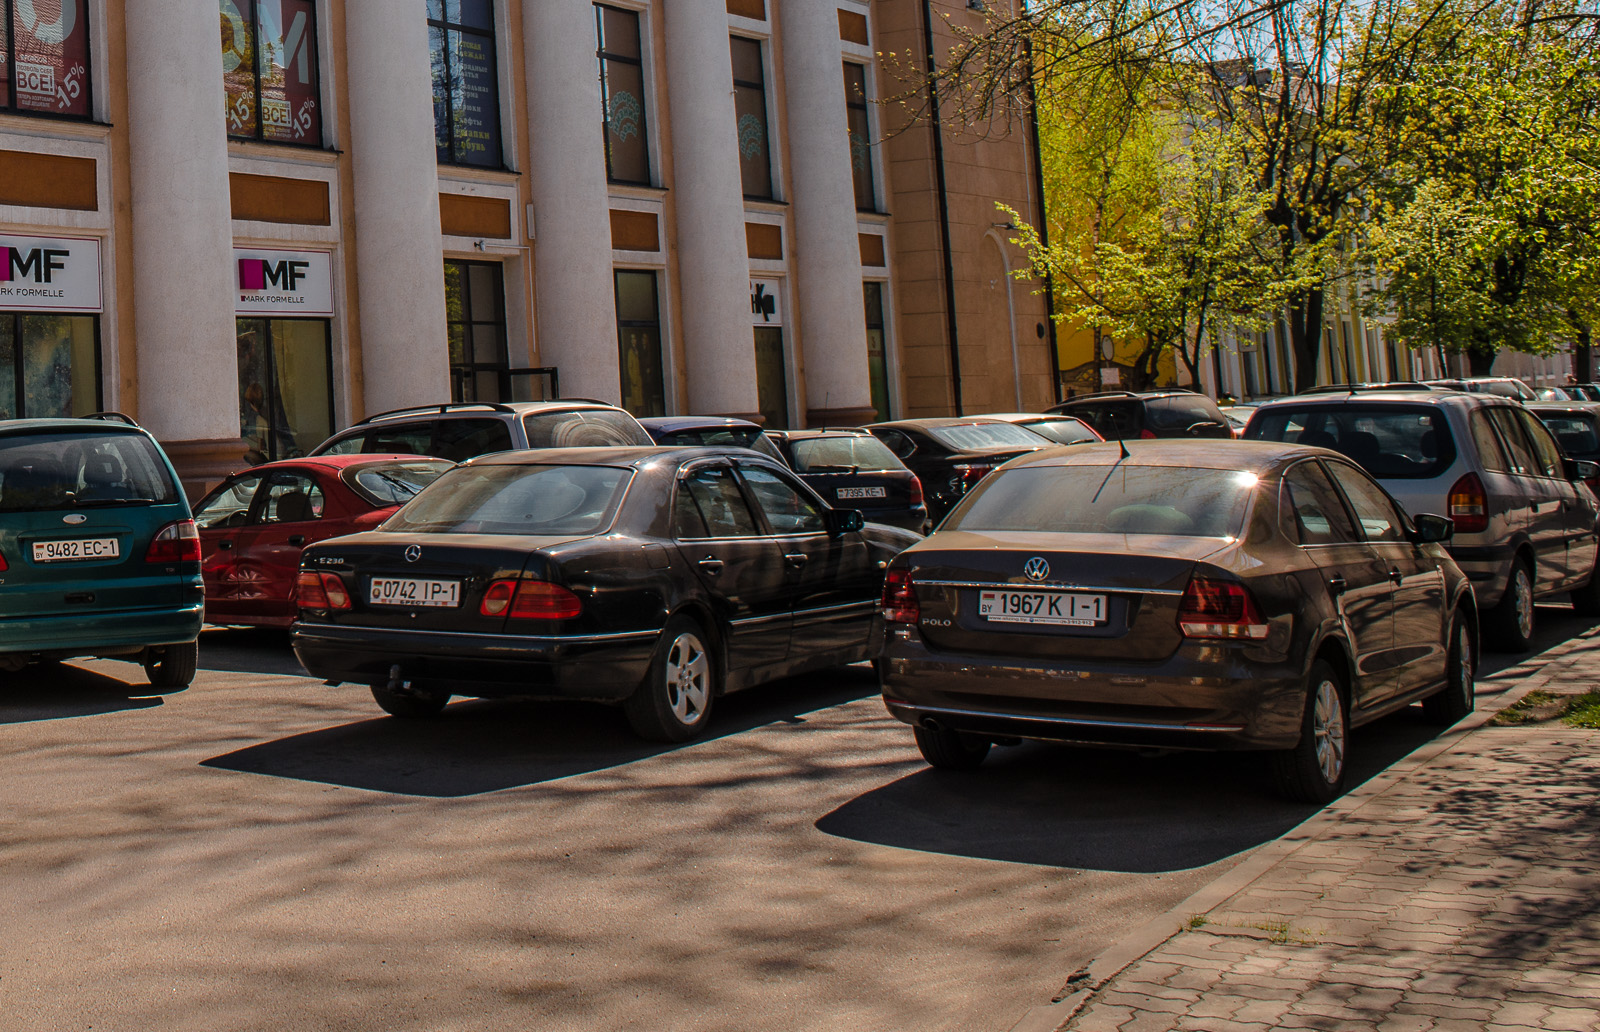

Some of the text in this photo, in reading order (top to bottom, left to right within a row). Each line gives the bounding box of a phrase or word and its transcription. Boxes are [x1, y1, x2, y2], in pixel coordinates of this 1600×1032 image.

[17, 71, 53, 92] ВСЕ!
[57, 62, 85, 109] -15%
[231, 88, 254, 130] -15%
[262, 106, 290, 124] ВСЕ!
[293, 97, 315, 139] -15%
[9, 246, 70, 283] MF
[262, 260, 310, 291] MF
[16, 288, 65, 298] FORMELLE
[244, 294, 305, 304] MARK FORMELLE
[844, 488, 864, 497] 7395
[47, 540, 115, 557] 9482 EC-1
[384, 580, 456, 601] 0742 IP-1
[981, 604, 992, 613] BY
[1001, 593, 1045, 615] 1967
[922, 618, 952, 627] POLO
